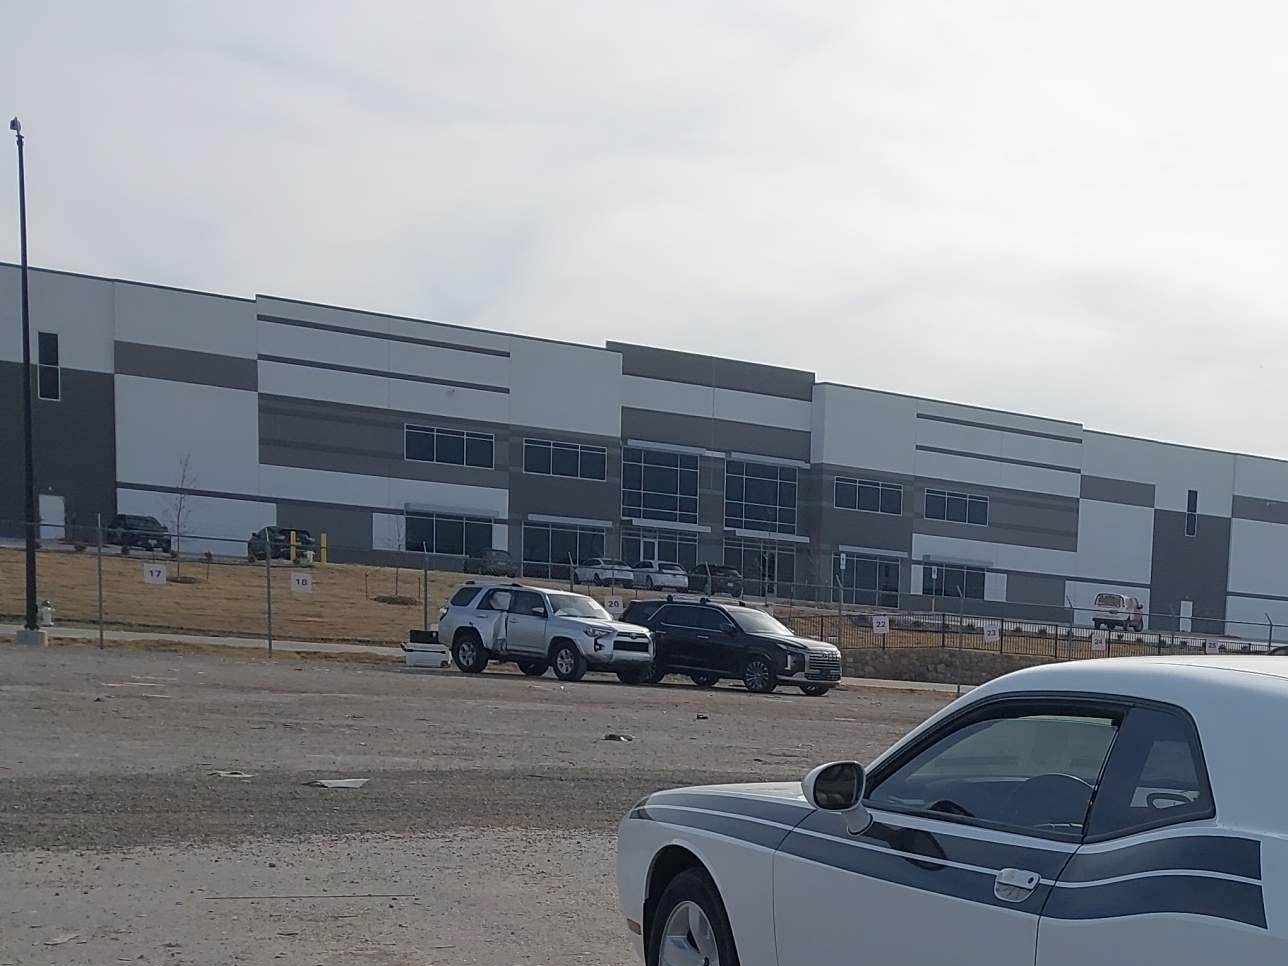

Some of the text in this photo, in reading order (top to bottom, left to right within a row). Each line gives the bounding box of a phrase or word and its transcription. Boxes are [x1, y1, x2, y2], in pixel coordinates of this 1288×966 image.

[149, 569, 161, 577] 17
[295, 578, 308, 586] 18
[608, 600, 620, 608] 20
